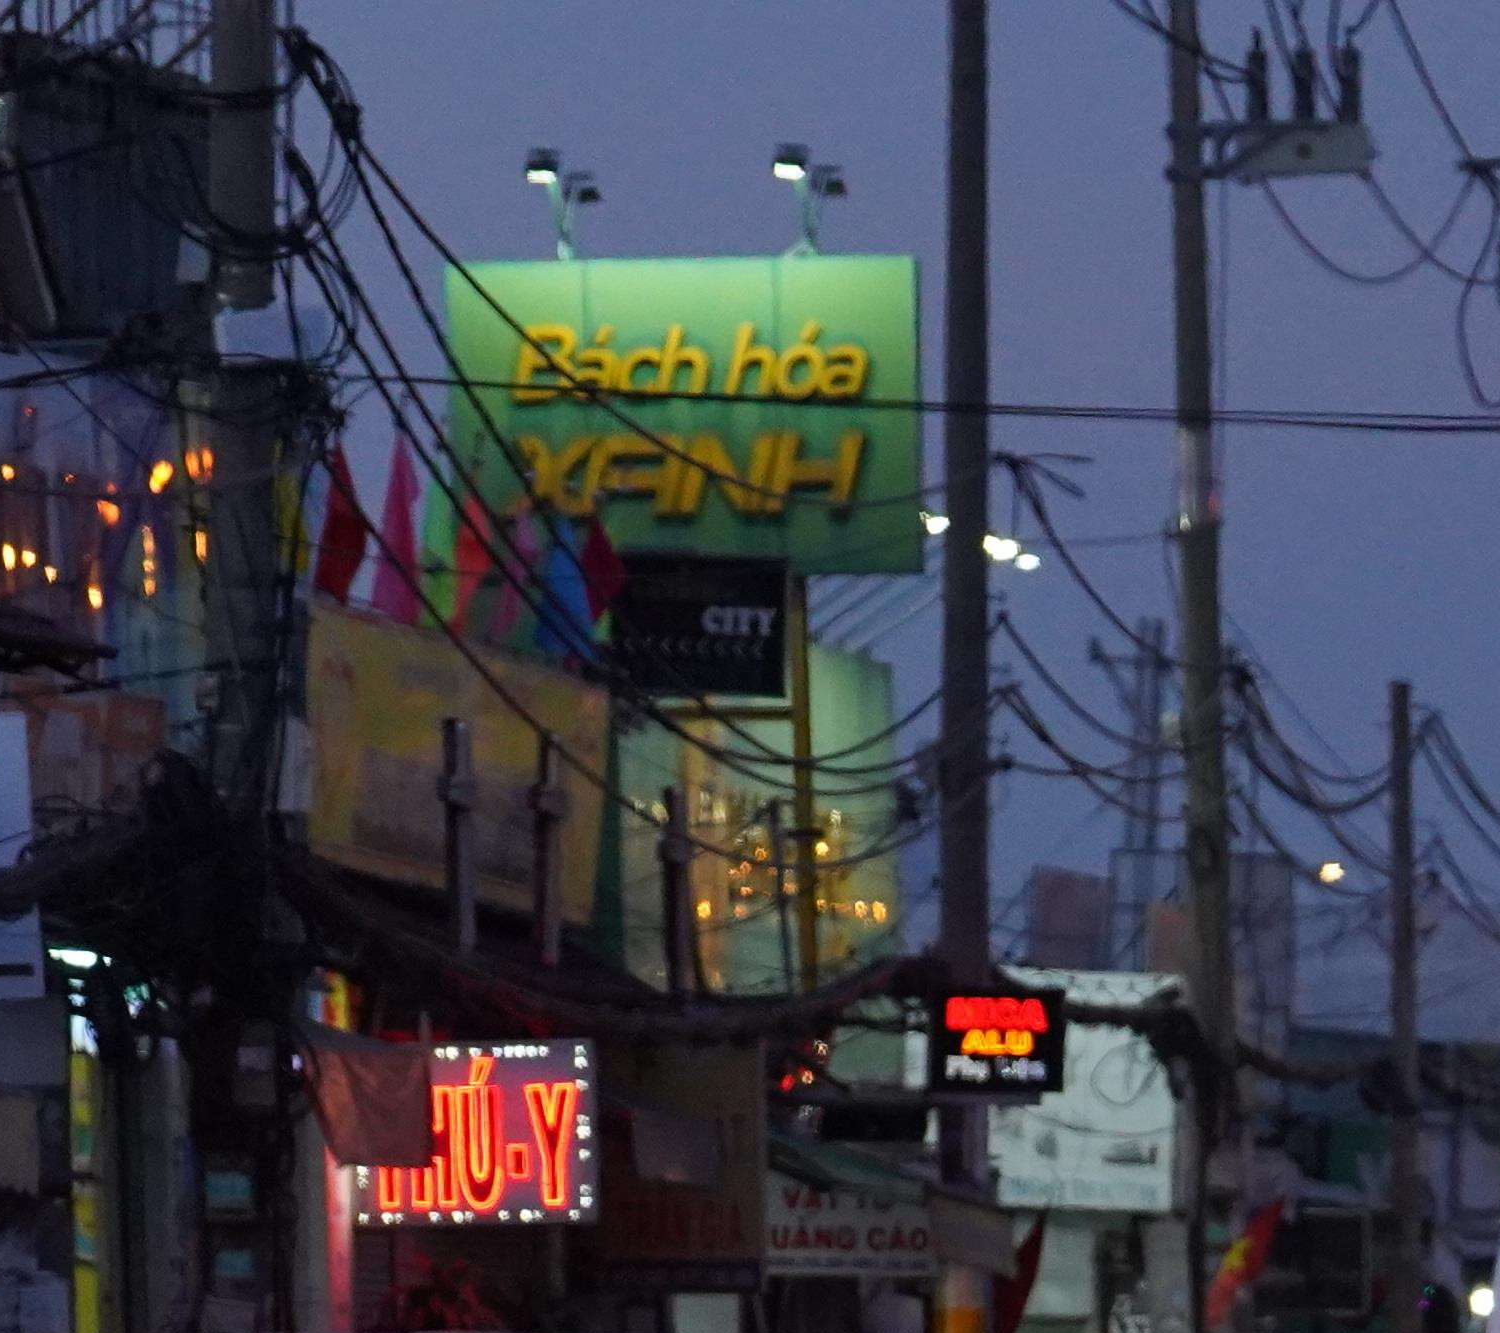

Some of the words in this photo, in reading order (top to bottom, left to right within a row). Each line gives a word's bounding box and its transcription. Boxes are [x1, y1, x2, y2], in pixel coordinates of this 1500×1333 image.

[512, 324, 710, 404] Bách
[725, 320, 870, 402] hóa
[513, 430, 865, 519] XANH
[961, 1027, 1036, 1057] ALU
